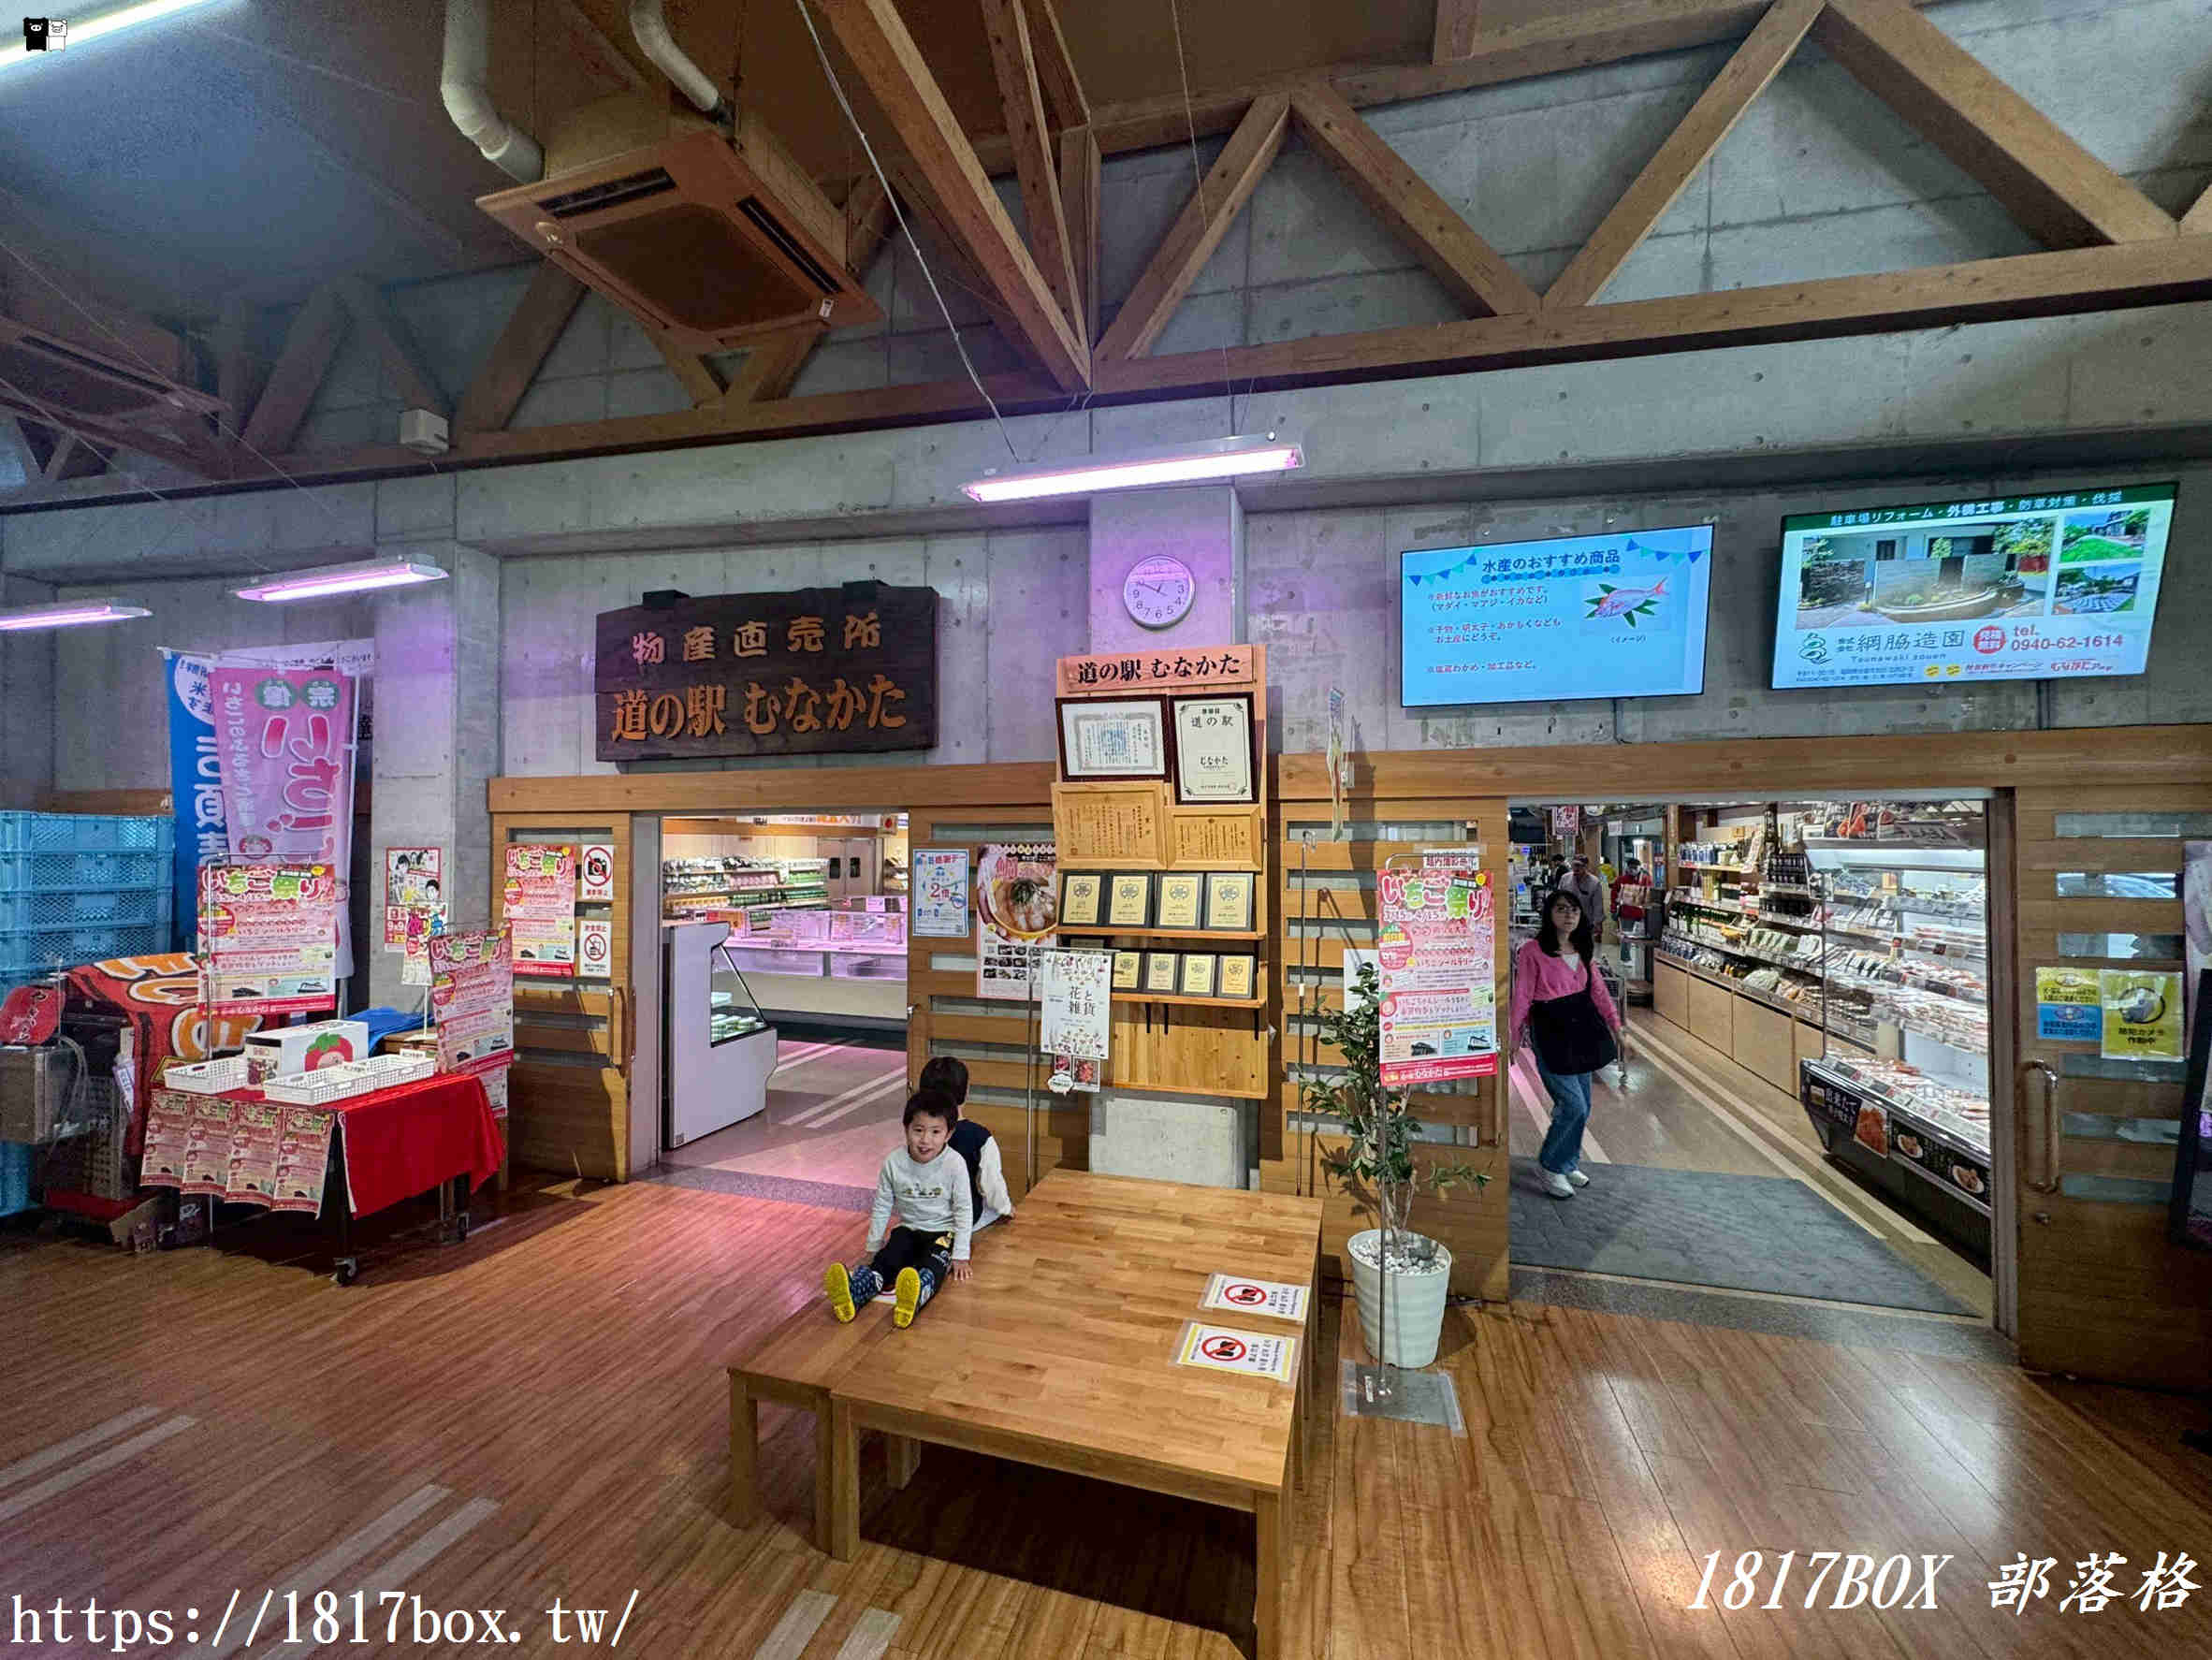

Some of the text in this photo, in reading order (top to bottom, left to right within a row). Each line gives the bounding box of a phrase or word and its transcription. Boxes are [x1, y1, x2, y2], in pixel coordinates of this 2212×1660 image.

[1482, 549, 1621, 573] 水産のおすすめ商品
[1132, 589, 1140, 598] 9
[1177, 584, 1185, 593] 3
[1136, 600, 1142, 609] 8
[1174, 597, 1182, 605] 4
[1144, 607, 1151, 616] 7
[1155, 609, 1162, 619] 6
[1167, 604, 1174, 614] 5
[2014, 624, 2039, 637] tel.
[632, 611, 881, 666] 物産直売所
[2012, 634, 2123, 652] 0940-62-1614
[1078, 653, 1241, 685] 道の駅 むなかた
[611, 674, 907, 742] 道の駅 むなかた
[1191, 715, 1233, 728] 道の駅
